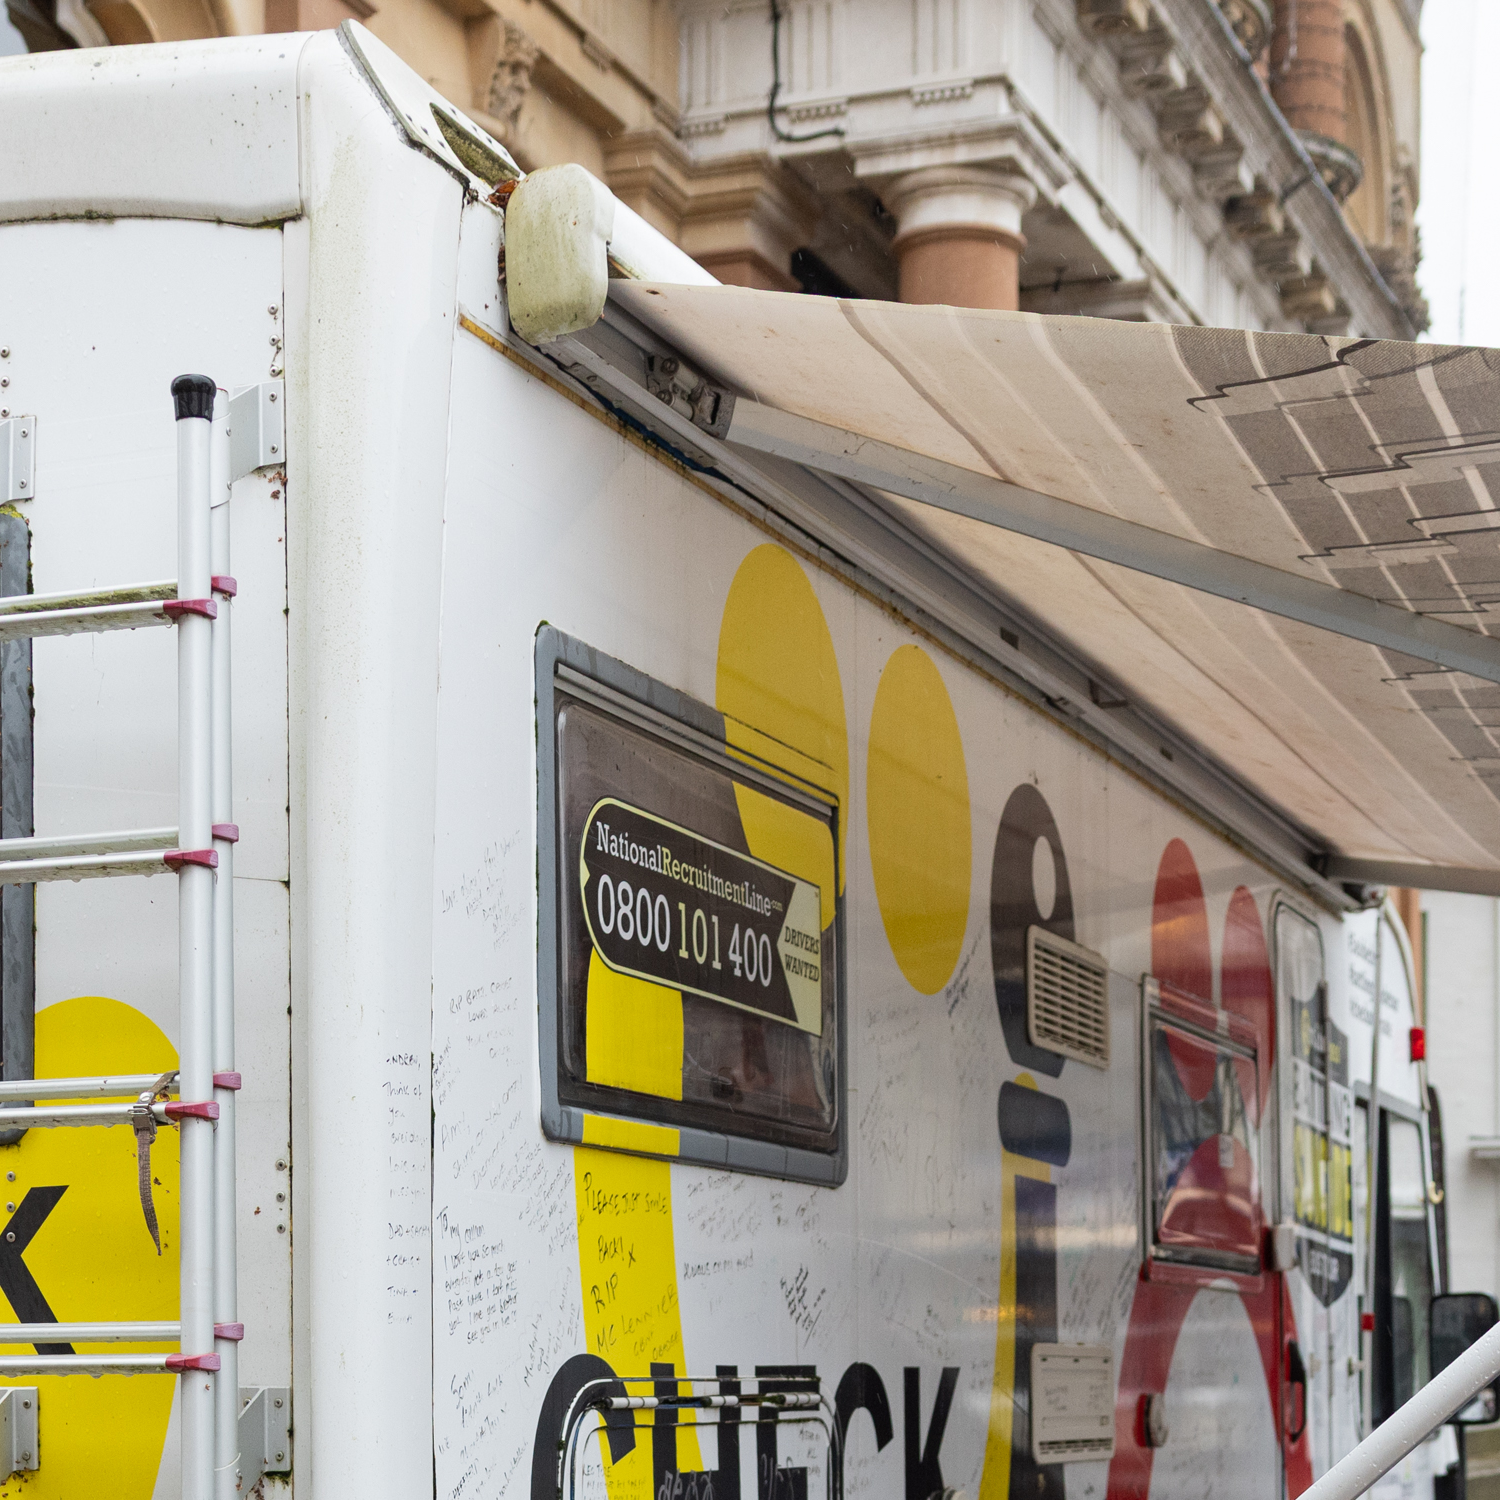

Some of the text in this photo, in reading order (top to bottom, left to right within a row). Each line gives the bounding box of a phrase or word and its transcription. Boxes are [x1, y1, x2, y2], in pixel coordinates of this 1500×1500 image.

[597, 874, 671, 952] 0800
[678, 902, 722, 970] 101
[728, 922, 772, 987] 400
[784, 925, 821, 955] DRIVERS
[784, 953, 820, 983] WANTED
